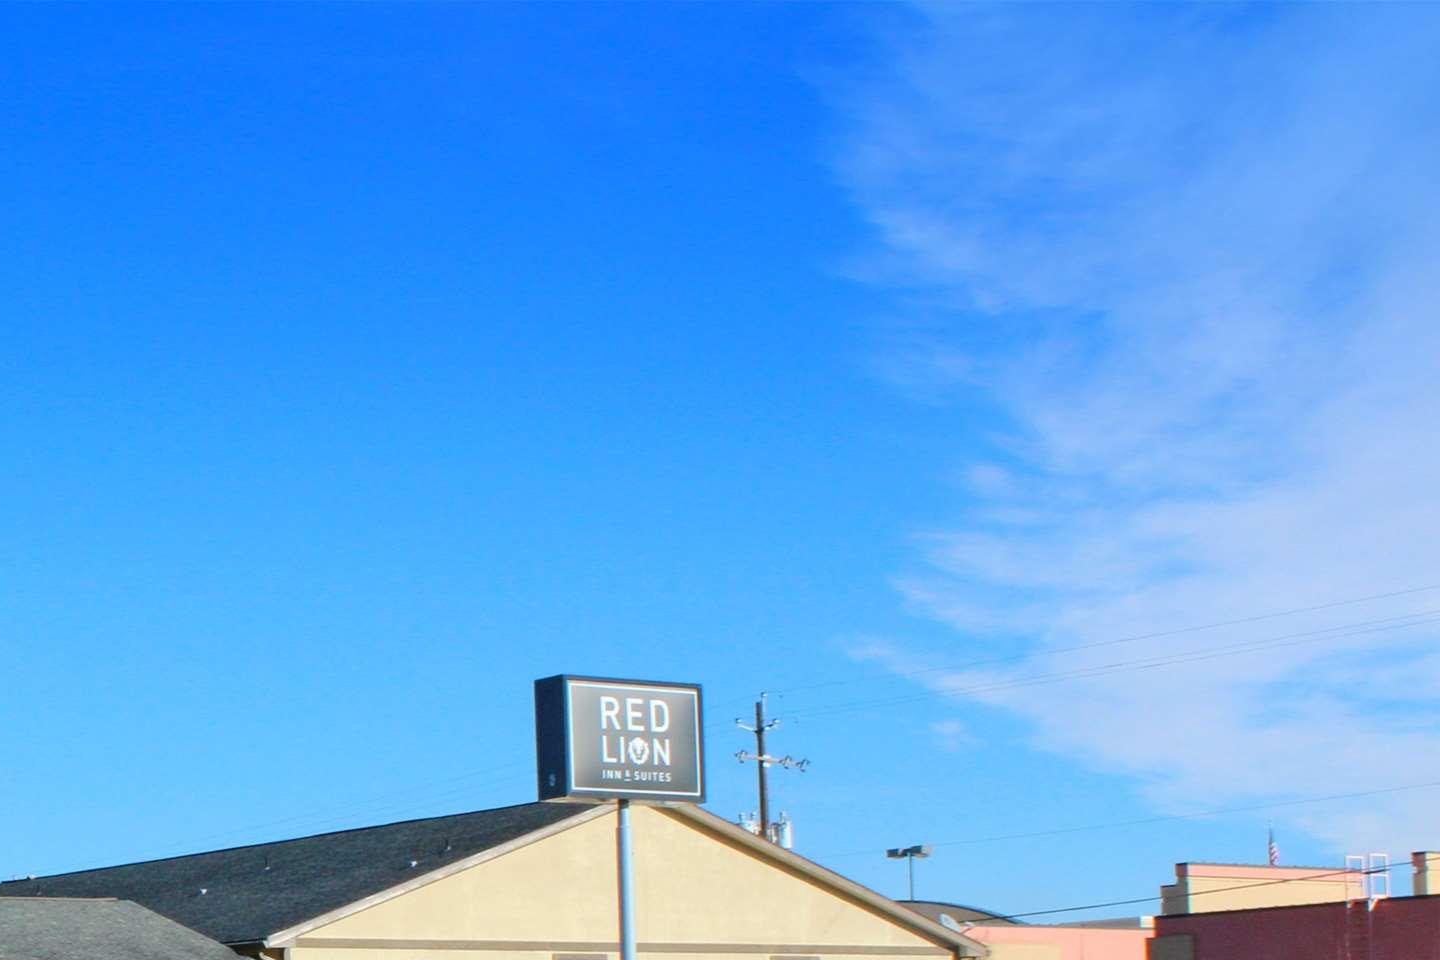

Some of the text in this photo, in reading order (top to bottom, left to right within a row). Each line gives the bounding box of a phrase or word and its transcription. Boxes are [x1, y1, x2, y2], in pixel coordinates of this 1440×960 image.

[600, 696, 670, 733] RED
[602, 735, 671, 766] LION
[602, 769, 622, 780] INN
[633, 770, 672, 783] SUITES
